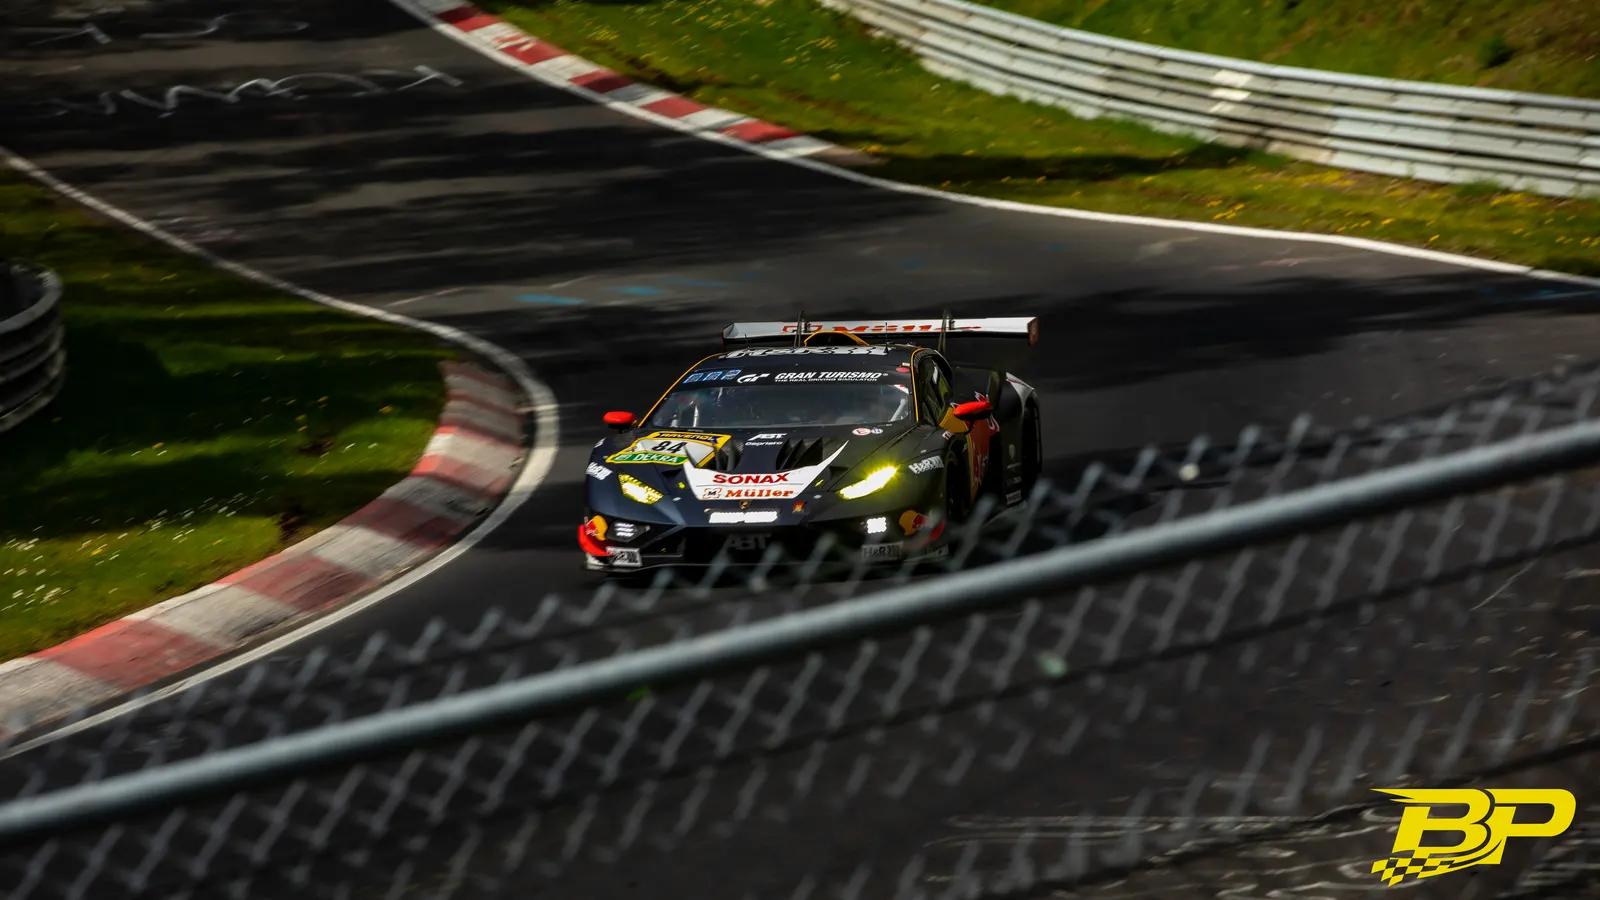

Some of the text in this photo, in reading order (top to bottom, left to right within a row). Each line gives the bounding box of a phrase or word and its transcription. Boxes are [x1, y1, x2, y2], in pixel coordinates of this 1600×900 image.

[832, 324, 982, 334] Müll
[774, 371, 882, 380] GRAN TURISMO
[659, 432, 715, 442] RAVENOL
[747, 432, 788, 442] ABT
[651, 440, 689, 454] 84
[633, 453, 678, 463] DEKRA
[712, 472, 791, 485] SONAX
[725, 488, 794, 499] Müller
